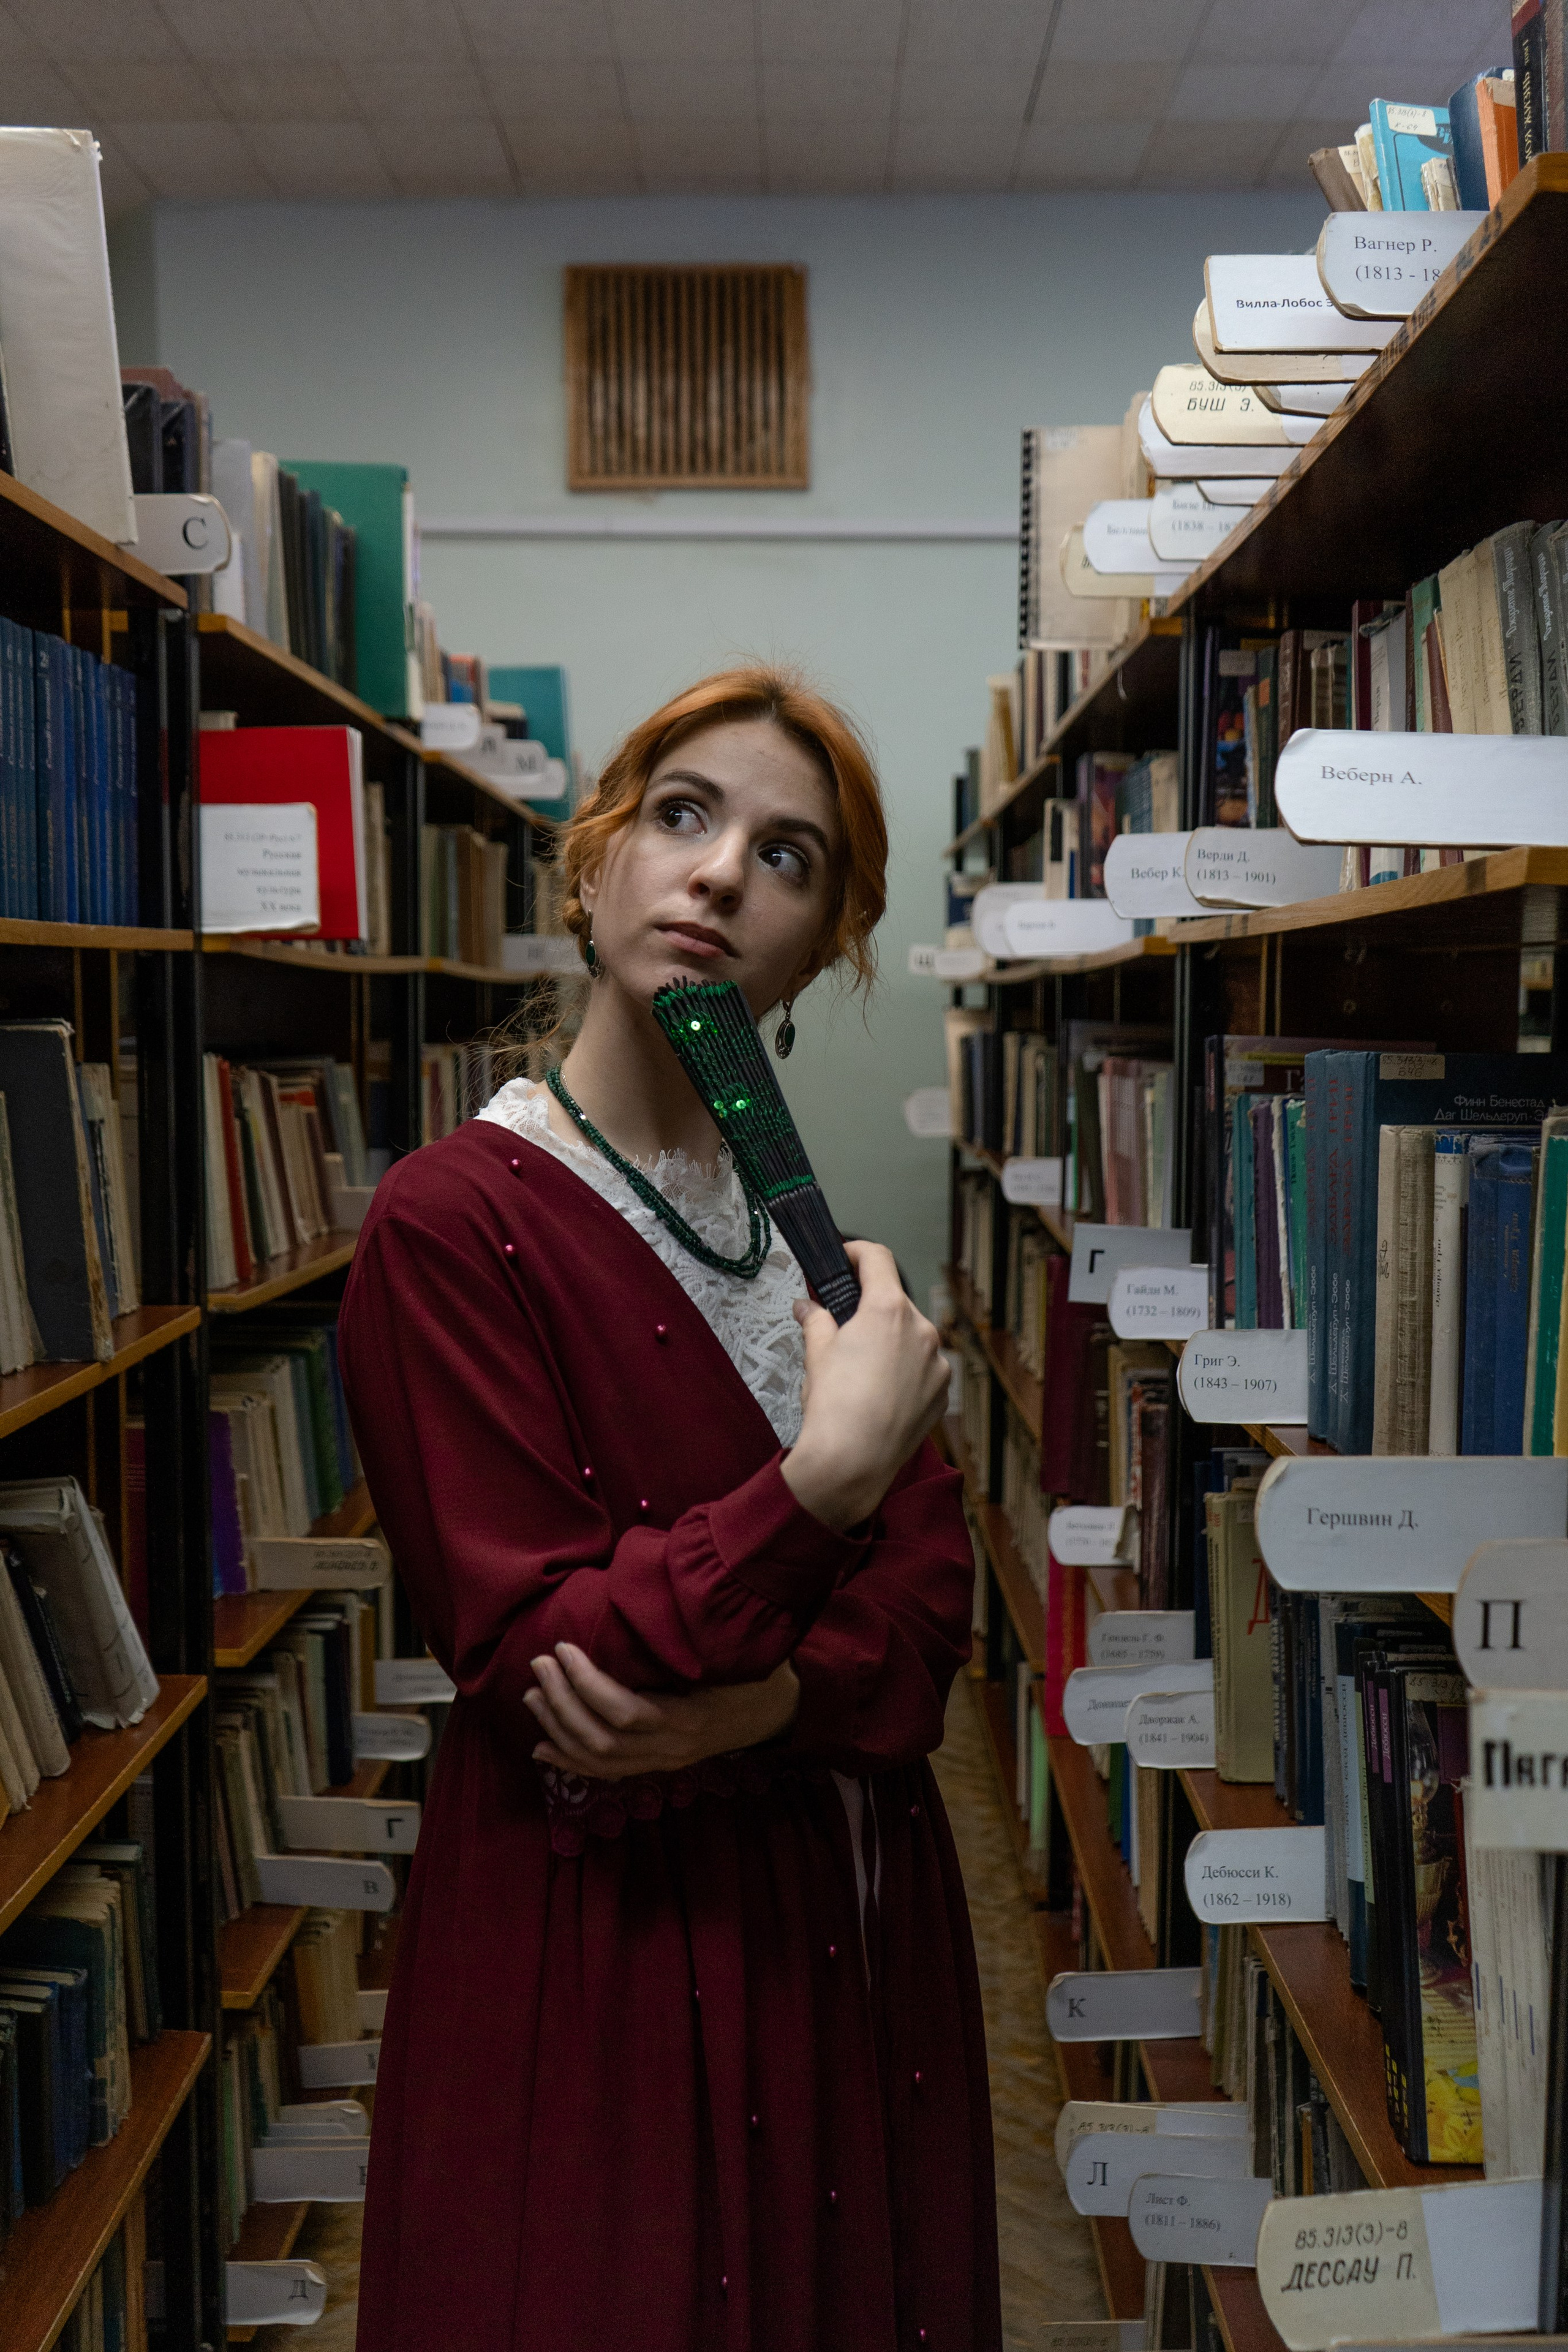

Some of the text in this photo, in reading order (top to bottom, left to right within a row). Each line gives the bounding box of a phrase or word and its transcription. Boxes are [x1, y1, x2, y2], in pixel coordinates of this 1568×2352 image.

[1354, 235, 1437, 255] Вагнер Р.
[1355, 265, 1403, 282] (1813
[1236, 298, 1323, 310] Вилла-Лобос
[1187, 398, 1226, 411] БУШ
[183, 516, 208, 549] С
[1508, 650, 1525, 734] ВЕРДИ
[1546, 649, 1561, 727] ВЕРДИ
[1321, 765, 1422, 786] Веберн А.
[1197, 848, 1250, 863] Верди Д.
[1131, 867, 1168, 880] Вебер
[1196, 869, 1229, 881] (1813
[1245, 871, 1276, 884] 1901)
[1328, 1073, 1338, 1132] ГРИГ
[1453, 1095, 1546, 1109] Финн Бенестад
[1434, 1107, 1457, 1121] Даг
[1088, 1249, 1105, 1273] Г
[1126, 1305, 1157, 1317] (1732
[1170, 1306, 1201, 1319] 1809)
[1194, 1354, 1240, 1369] Григ Э.
[1194, 1376, 1227, 1390] (1843
[1244, 1378, 1278, 1394] 1907)
[1306, 1507, 1419, 1531] Гершвин Д.
[1475, 1599, 1527, 1651] П
[1381, 1712, 1390, 1758] Дебюсси
[386, 1818, 403, 1839] Г
[1202, 1865, 1279, 1880] Дебюсси К.
[1203, 1892, 1239, 1909] (1862
[1256, 1892, 1292, 1909] 1918)
[1067, 1997, 1087, 2019] К
[1087, 2160, 1110, 2187] Л
[1145, 2193, 1191, 2206] Лист Ф.
[1145, 2214, 1175, 2227] (1811
[1281, 2252, 1416, 2293] ДЕССАУ П.
[289, 2279, 309, 2300] Д
